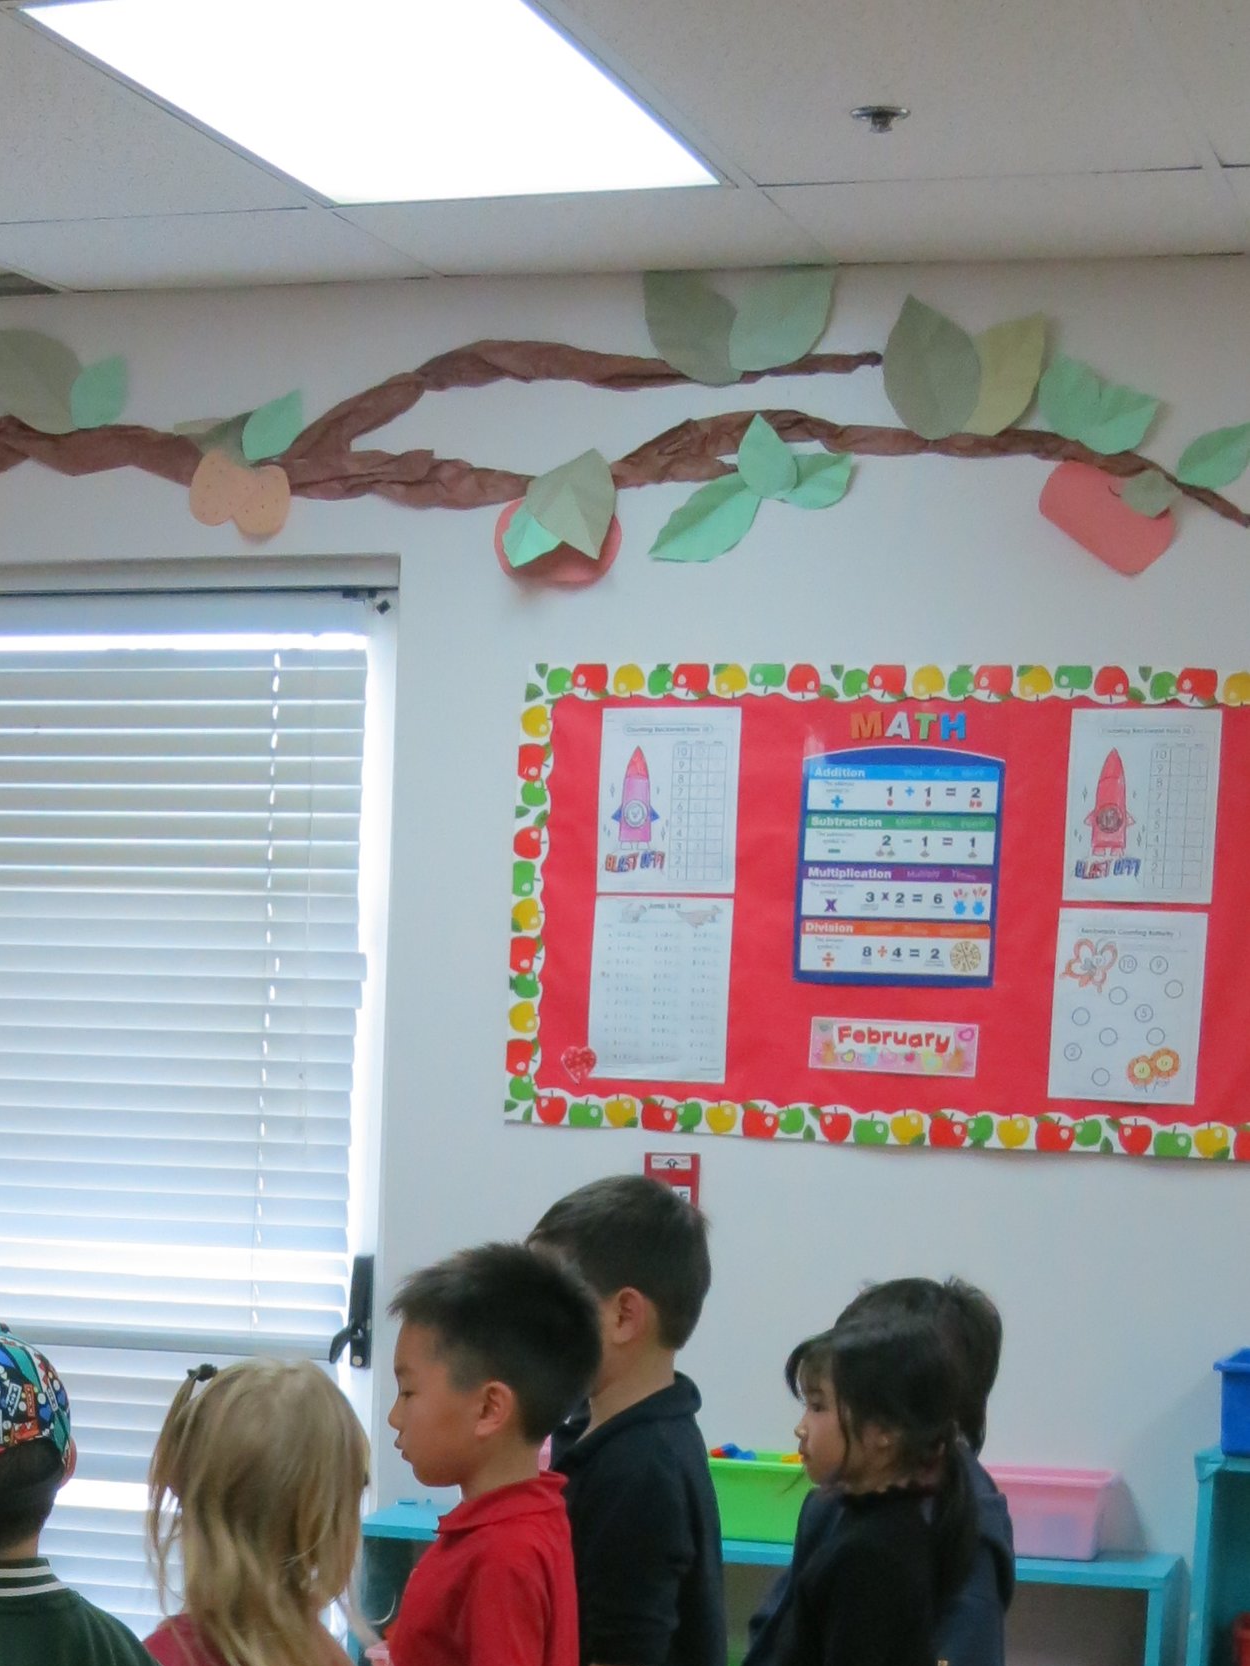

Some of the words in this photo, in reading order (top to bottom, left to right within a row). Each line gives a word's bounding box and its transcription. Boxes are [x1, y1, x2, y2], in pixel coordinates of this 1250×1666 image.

[850, 711, 967, 741] MATH
[814, 767, 866, 778] Addition
[886, 786, 893, 798] 1
[925, 786, 931, 798] 1
[971, 787, 981, 798] 2
[811, 816, 883, 828] Subtraction
[882, 835, 892, 846] 2
[921, 835, 928, 847] 1
[969, 837, 976, 848] 1
[808, 867, 892, 880] Multiplication
[865, 891, 875, 903] 3
[895, 892, 905, 904] 2
[933, 893, 943, 904] 6
[805, 922, 854, 934] Division
[862, 946, 872, 958] 8
[892, 947, 902, 958] 4
[930, 948, 940, 960] 2
[1122, 960, 1135, 969] 10
[837, 1025, 951, 1056] February
